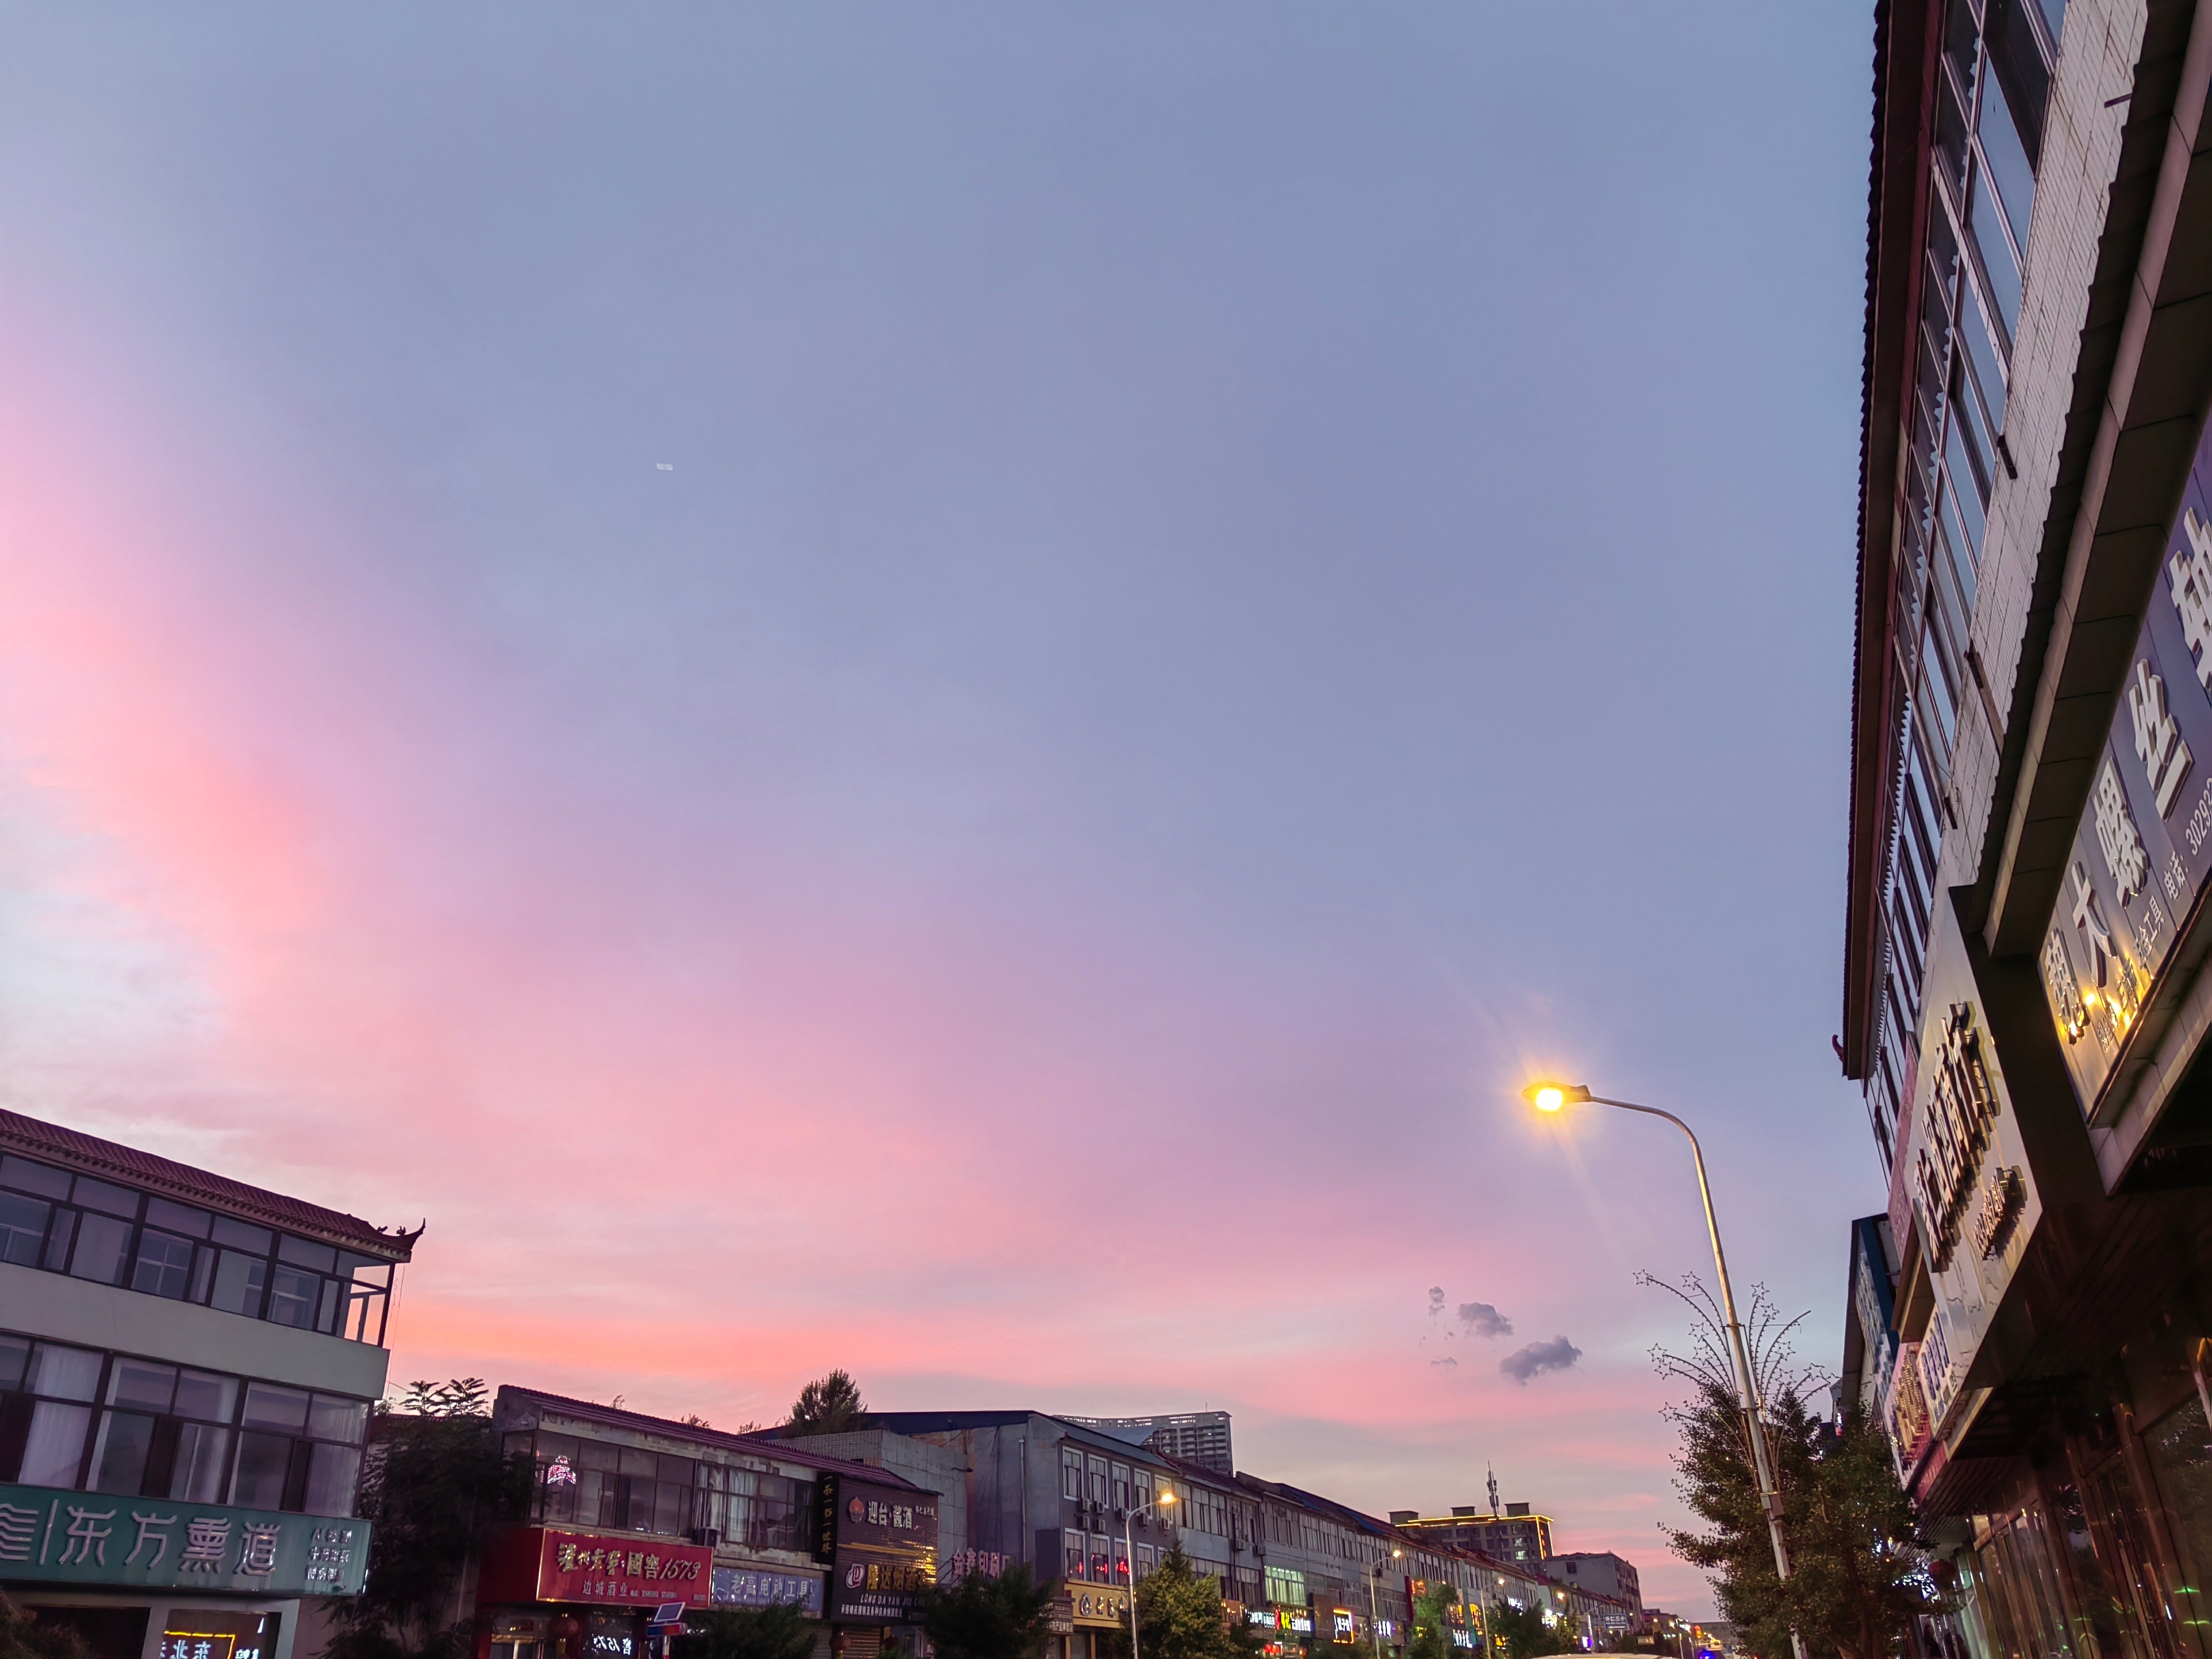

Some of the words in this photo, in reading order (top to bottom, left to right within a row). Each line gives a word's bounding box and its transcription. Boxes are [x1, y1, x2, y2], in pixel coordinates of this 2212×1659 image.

[582, 1579, 628, 1598] 边城酒业
[731, 1574, 808, 1598] 老高电动工具
[860, 1593, 876, 1603] LONG
[878, 1595, 886, 1605] DA
[888, 1596, 900, 1606] YAN
[902, 1597, 912, 1606] JIU
